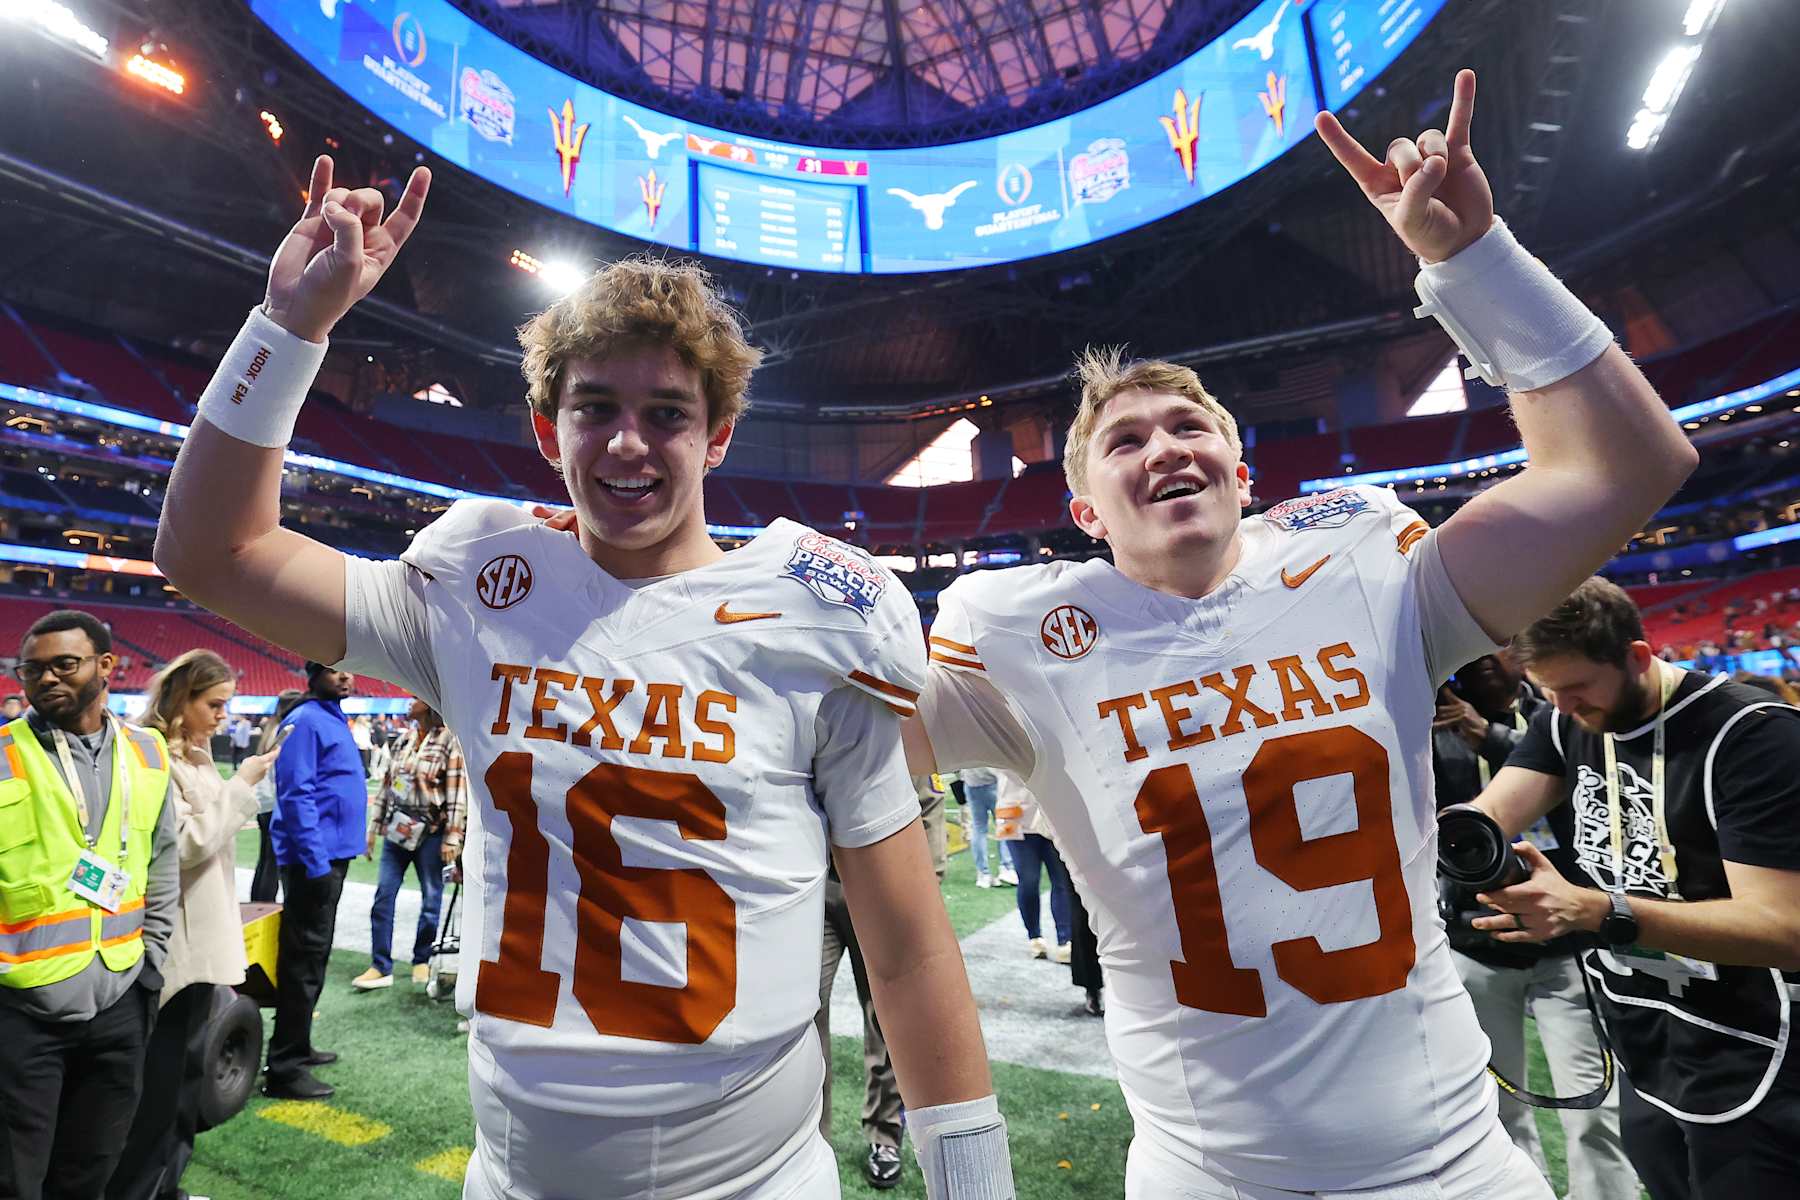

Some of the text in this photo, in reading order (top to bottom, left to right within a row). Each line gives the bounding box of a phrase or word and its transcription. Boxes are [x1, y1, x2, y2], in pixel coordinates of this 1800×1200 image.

[804, 159, 823, 173] 31
[975, 209, 1061, 237] QUARTERFINAL
[245, 346, 272, 381] HOOK
[477, 556, 532, 608] SEC
[787, 548, 882, 607] PEACH
[804, 568, 856, 601] BOWL
[1041, 606, 1097, 657] SEC
[490, 662, 737, 764] TEXAS
[1097, 641, 1371, 762] TEXAS
[1133, 724, 1417, 1018] 19
[475, 750, 737, 1045] 16
